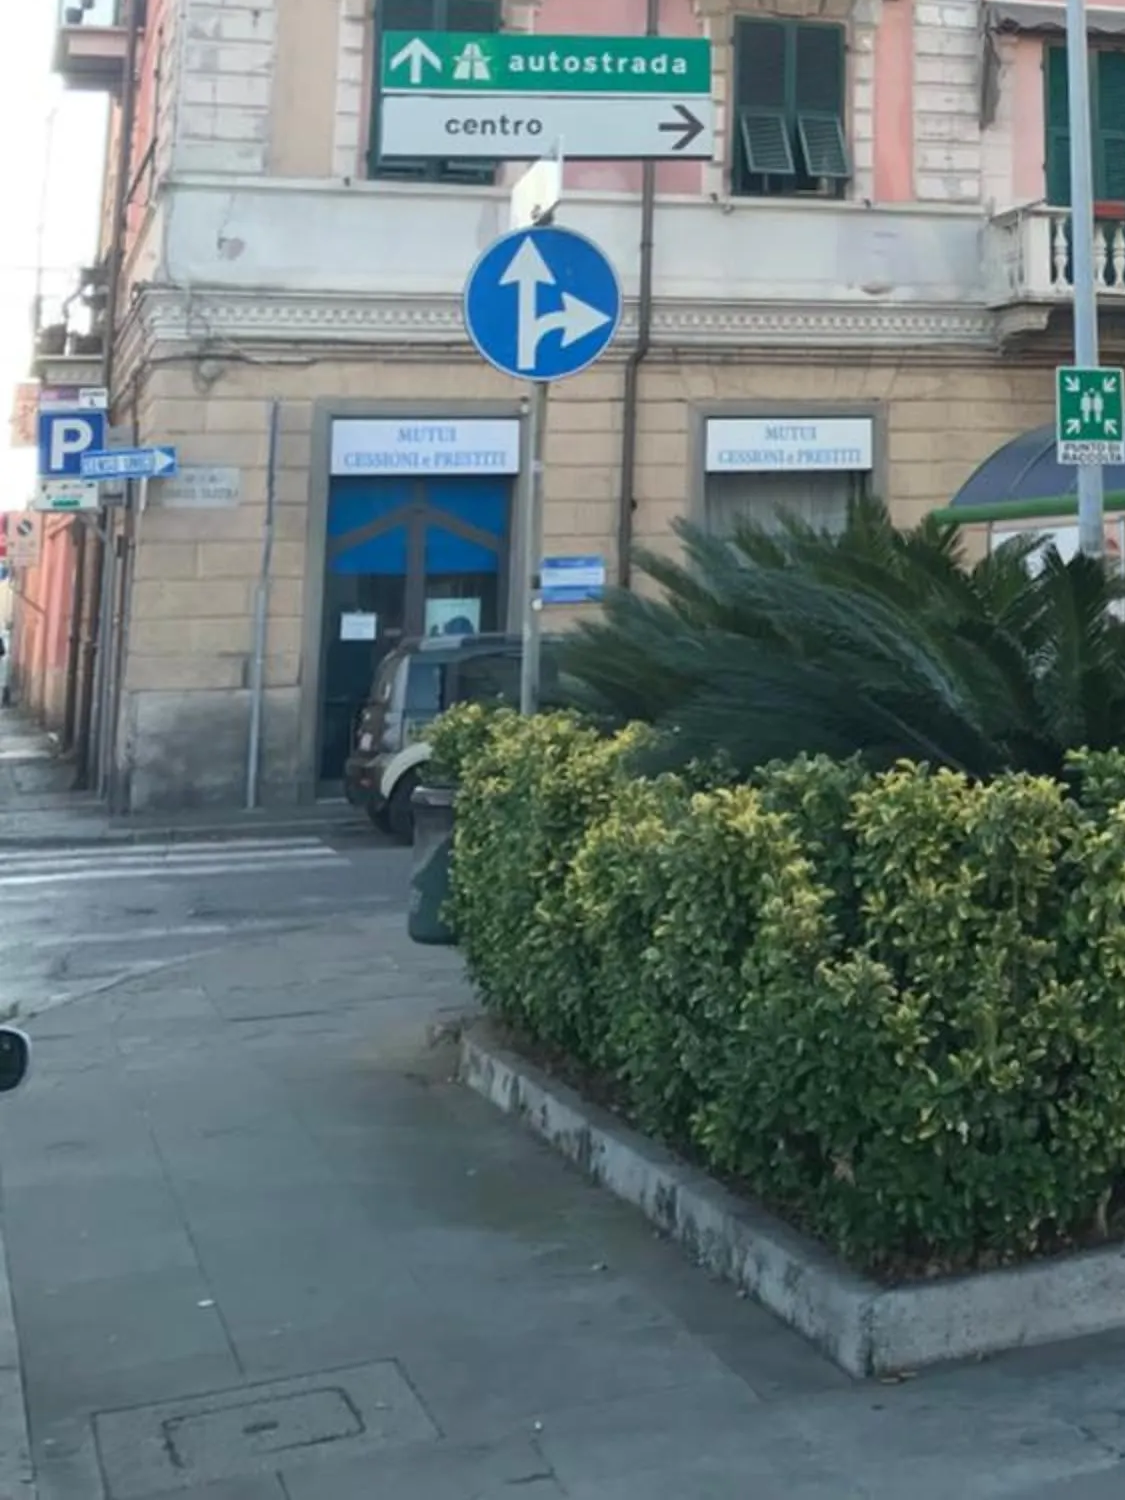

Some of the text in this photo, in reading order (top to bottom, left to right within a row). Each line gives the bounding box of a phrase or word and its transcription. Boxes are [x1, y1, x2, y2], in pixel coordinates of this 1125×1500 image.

[508, 52, 688, 75] autostrada
[445, 115, 543, 136] centro
[397, 426, 457, 443] MUTUI
[764, 425, 817, 442] MUTUI
[51, 419, 93, 470] P
[1064, 443, 1105, 452] PUNTO
[343, 451, 507, 469] CESSIONI e PRESTITI
[717, 449, 862, 465] CESSIONI e PRESTITI
[1062, 452, 1122, 462] RACCOLTA
